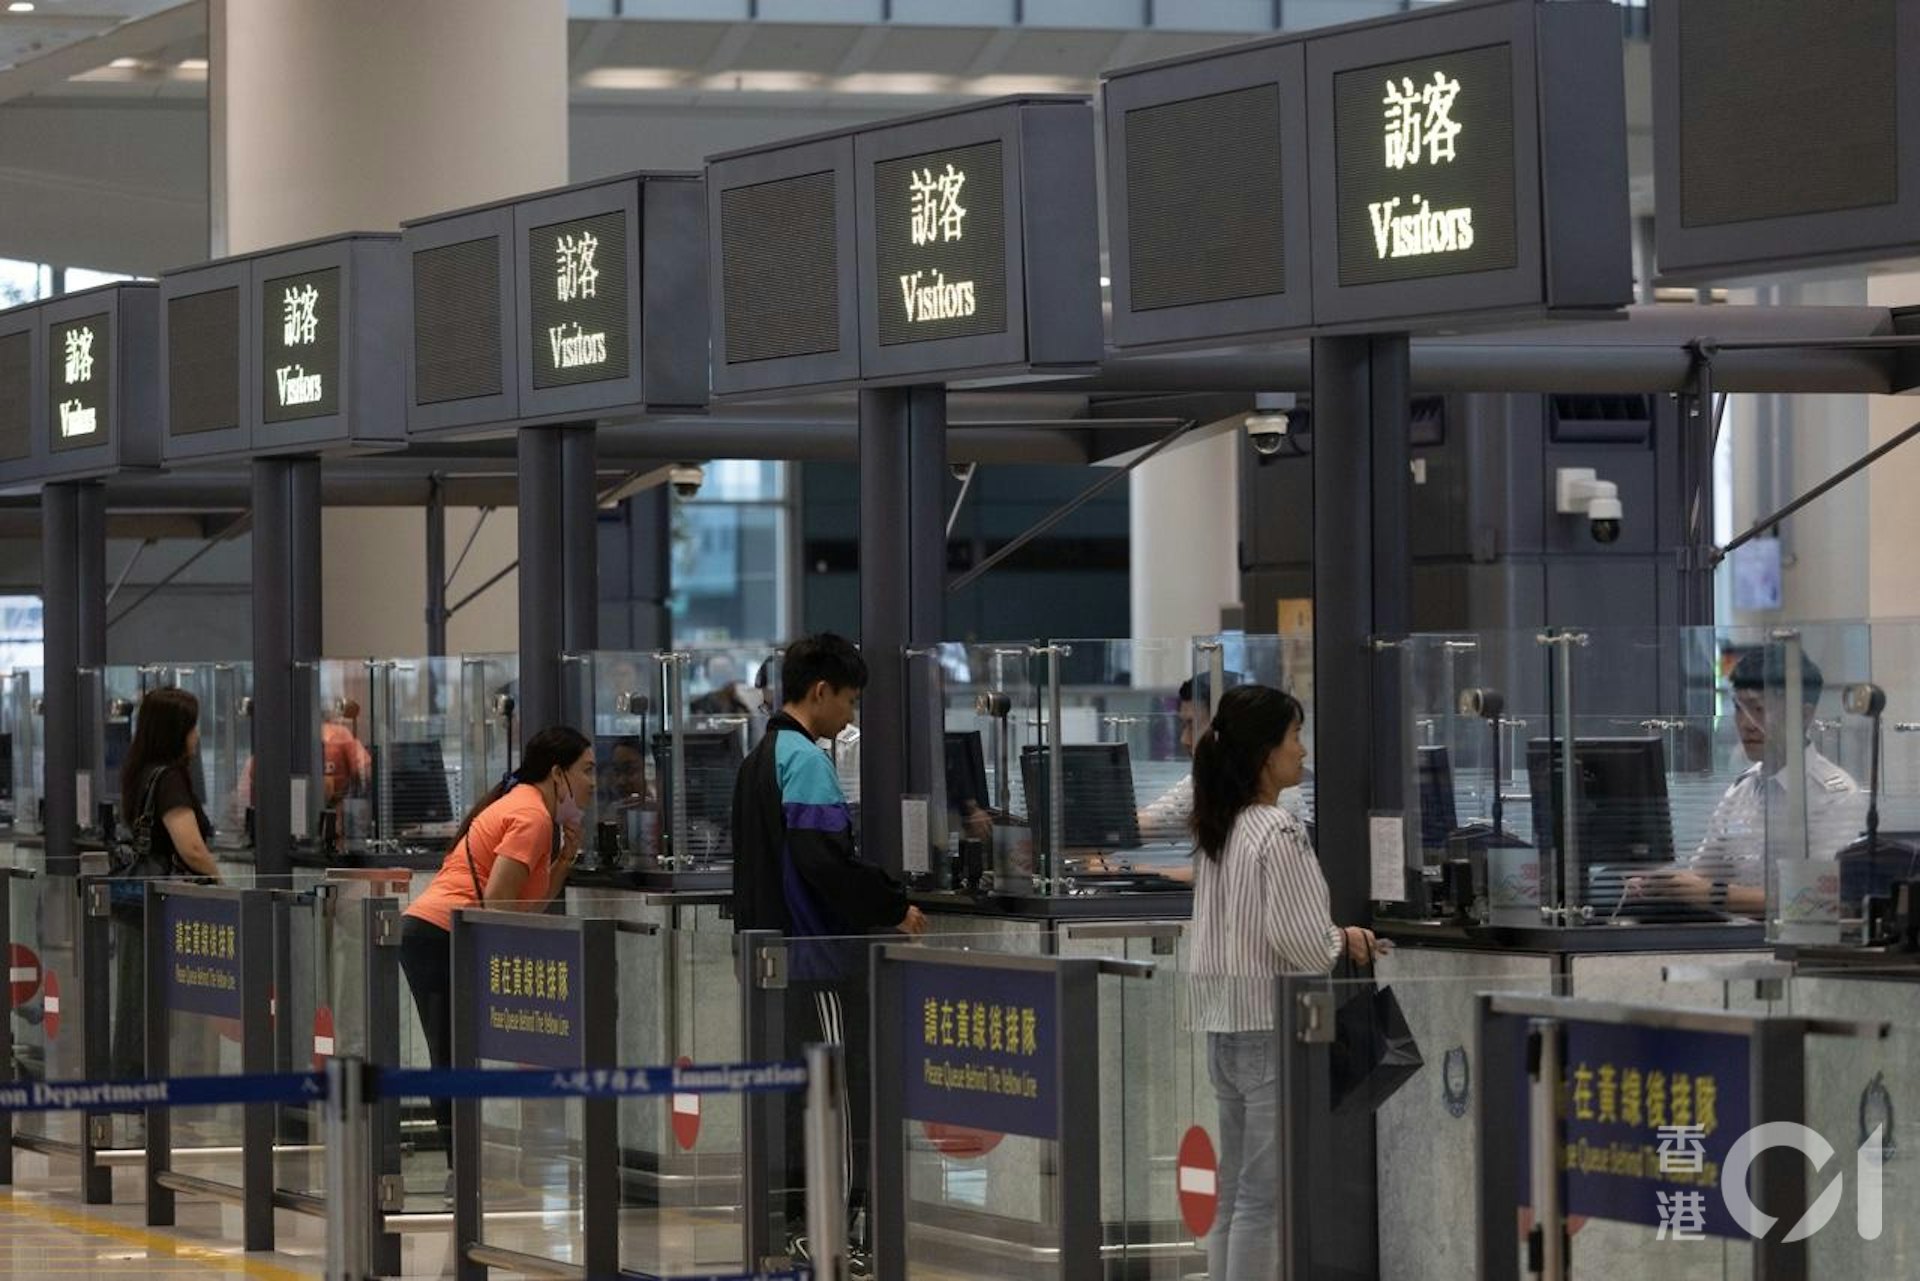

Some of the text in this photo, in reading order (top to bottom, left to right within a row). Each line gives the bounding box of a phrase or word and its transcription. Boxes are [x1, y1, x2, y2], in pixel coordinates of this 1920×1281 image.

[1383, 71, 1463, 170] 訪客
[909, 163, 967, 246] 訪客
[1368, 193, 1474, 259] Visitors
[555, 231, 600, 302] 訪客
[900, 267, 976, 323] Visitors
[283, 283, 319, 347] 訪客
[548, 321, 607, 369] Visitors
[65, 325, 95, 384] 訪客
[276, 363, 322, 406] Visitors
[33, 1082, 168, 1108] Department
[924, 1058, 945, 1086] Please
[945, 1061, 964, 1091] Queue
[965, 1062, 986, 1091] Behind
[1559, 1060, 1718, 1137] 在黃線後排隊
